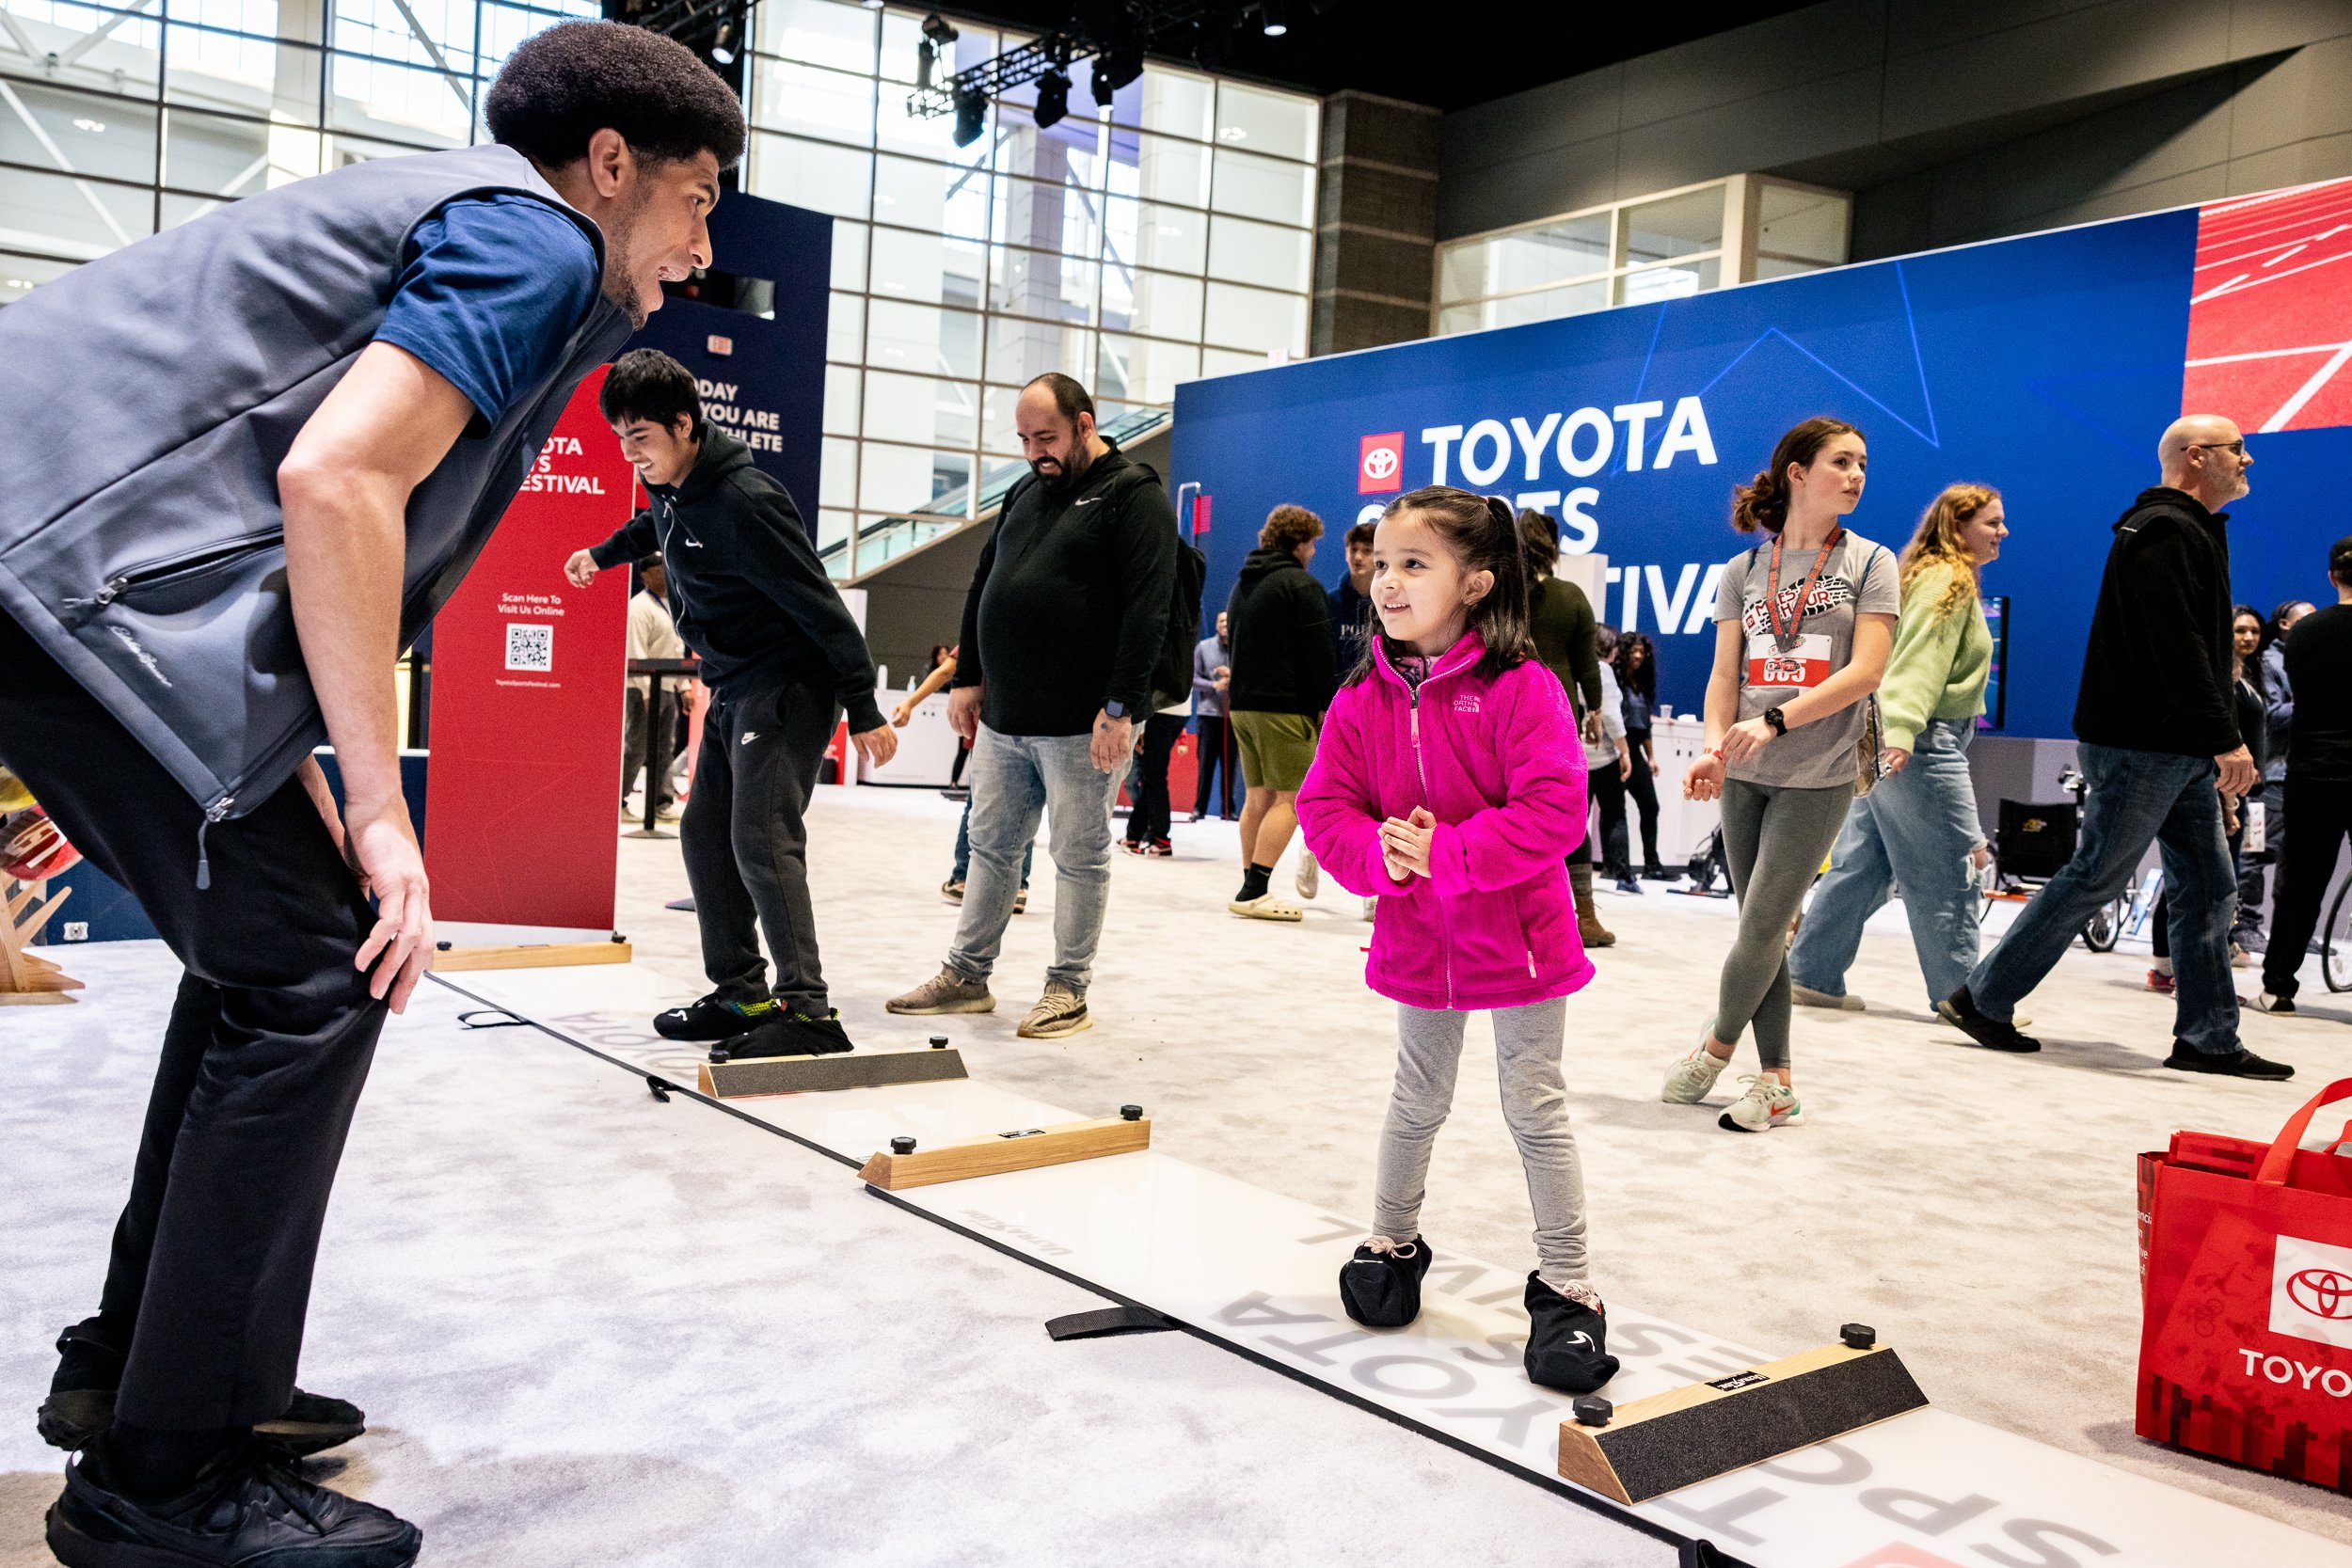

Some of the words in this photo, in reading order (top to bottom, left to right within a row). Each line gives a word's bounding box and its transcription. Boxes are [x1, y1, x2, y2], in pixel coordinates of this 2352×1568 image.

[699, 401, 740, 424] YOU
[742, 409, 780, 431] ARE
[1422, 395, 1718, 486] TOYOTA
[519, 473, 606, 495] ESTIVAL
[497, 604, 517, 614] Visit
[519, 605, 532, 614] Us
[532, 606, 564, 616] Online
[501, 593, 525, 602] Scan
[526, 594, 548, 604] Here
[549, 594, 562, 605] To
